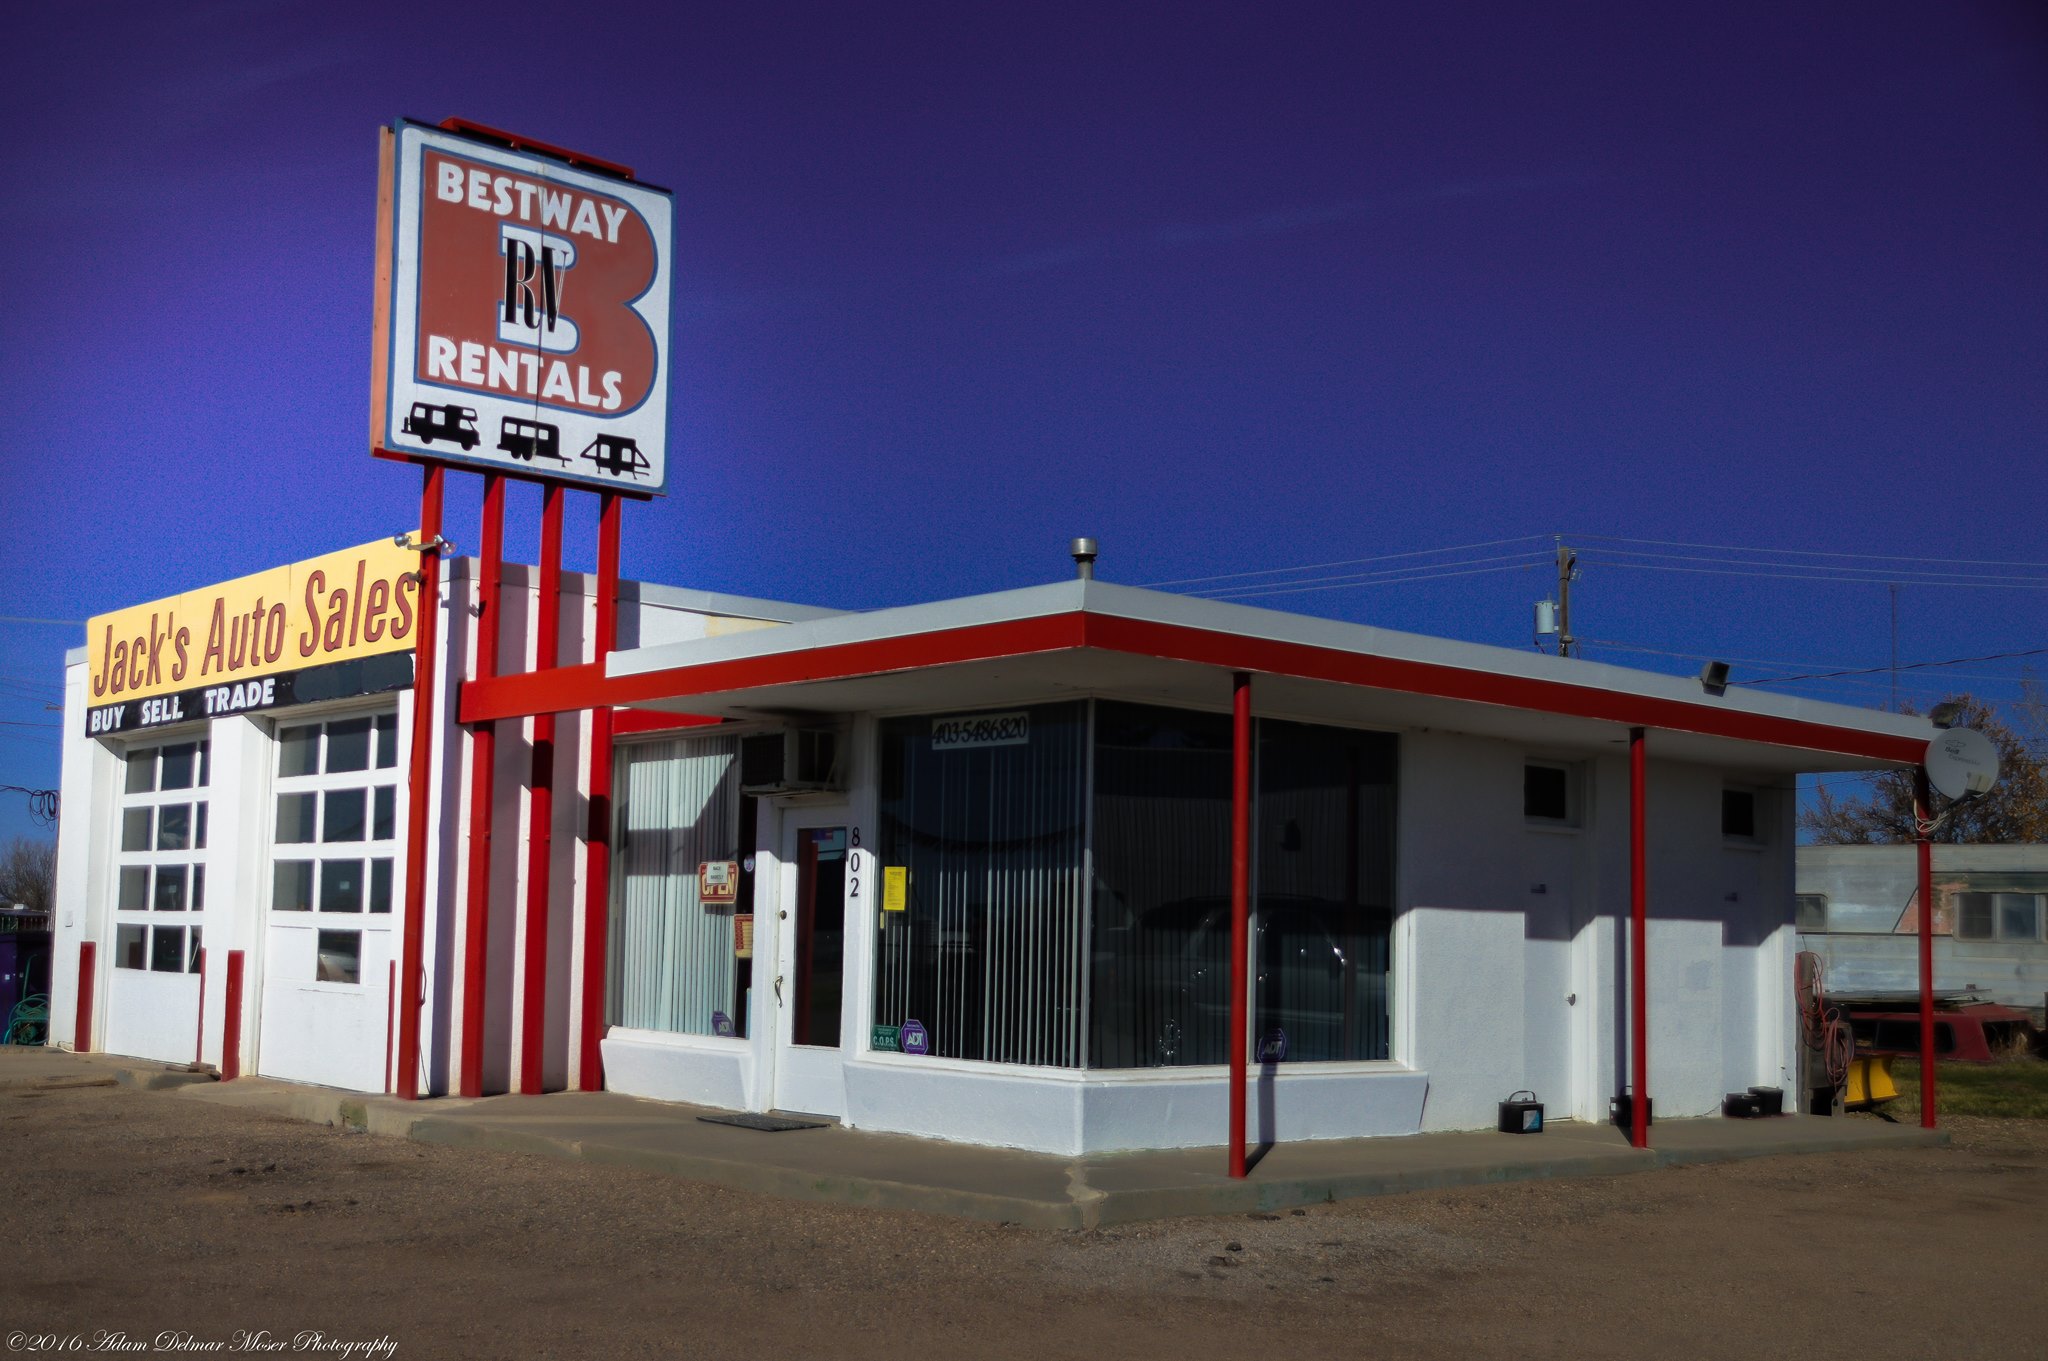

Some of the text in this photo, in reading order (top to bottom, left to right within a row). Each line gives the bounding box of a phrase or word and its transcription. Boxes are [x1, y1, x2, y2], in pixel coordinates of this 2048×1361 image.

[437, 161, 627, 243] BESTWAY
[501, 237, 569, 333] RV
[428, 335, 622, 410] RENTALS
[94, 560, 416, 697] Jack's Auto Sales
[91, 678, 276, 732] BUY SELL TRADE
[851, 827, 860, 897] 802
[907, 1032, 923, 1045] ADT
